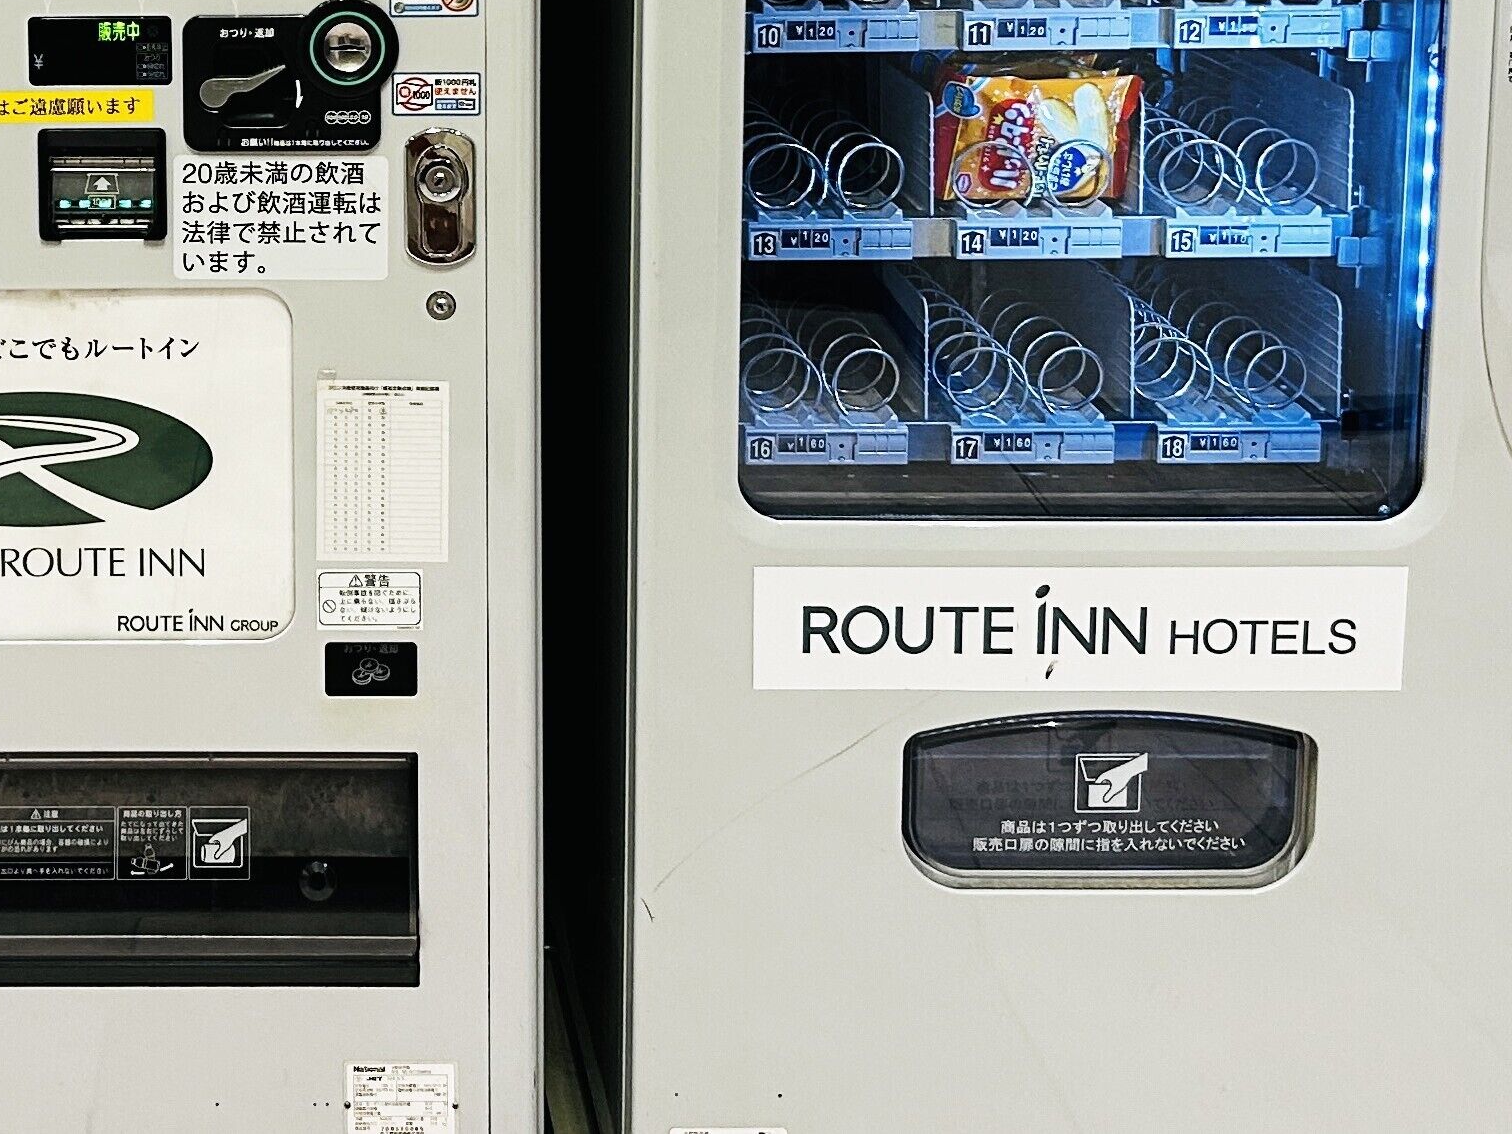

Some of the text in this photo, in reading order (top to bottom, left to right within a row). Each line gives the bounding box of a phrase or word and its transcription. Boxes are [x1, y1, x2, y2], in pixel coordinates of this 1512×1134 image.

[98, 21, 140, 41] 販売中
[759, 25, 834, 46] 10 ¥120
[970, 21, 1045, 44] 11 ¥120
[1180, 23, 1200, 42] 12
[33, 53, 44, 70] ¥
[434, 78, 477, 87] 新1000円札
[434, 87, 477, 96] 使えません
[182, 160, 365, 185] 20歳未満の飲酒
[182, 190, 382, 215] および飲酒運転は
[182, 220, 382, 245] 法律で禁止されて
[754, 229, 830, 253] 13 ¥120
[962, 229, 1038, 252] 14 ¥120
[1171, 232, 1192, 252] 15
[182, 250, 266, 274] います。
[750, 436, 826, 458] 16 ¥160
[955, 436, 1032, 457] 17 ¥160
[1161, 436, 1238, 457] 18 ¥160
[0, 547, 126, 579] ROUTE
[138, 547, 206, 578] INN
[364, 573, 390, 587] 警告
[117, 615, 184, 632] ROUTE
[230, 619, 279, 632] GROUP
[802, 604, 1014, 654] ROUTE
[1170, 617, 1357, 655] HOTELS
[43, 810, 59, 818] 注意
[122, 810, 183, 818] 商品の取り出し方
[1000, 819, 1220, 834] 商品は1つずつ取り出してください
[972, 837, 1246, 853] 販売口扉の隙間に指を入れないでください
